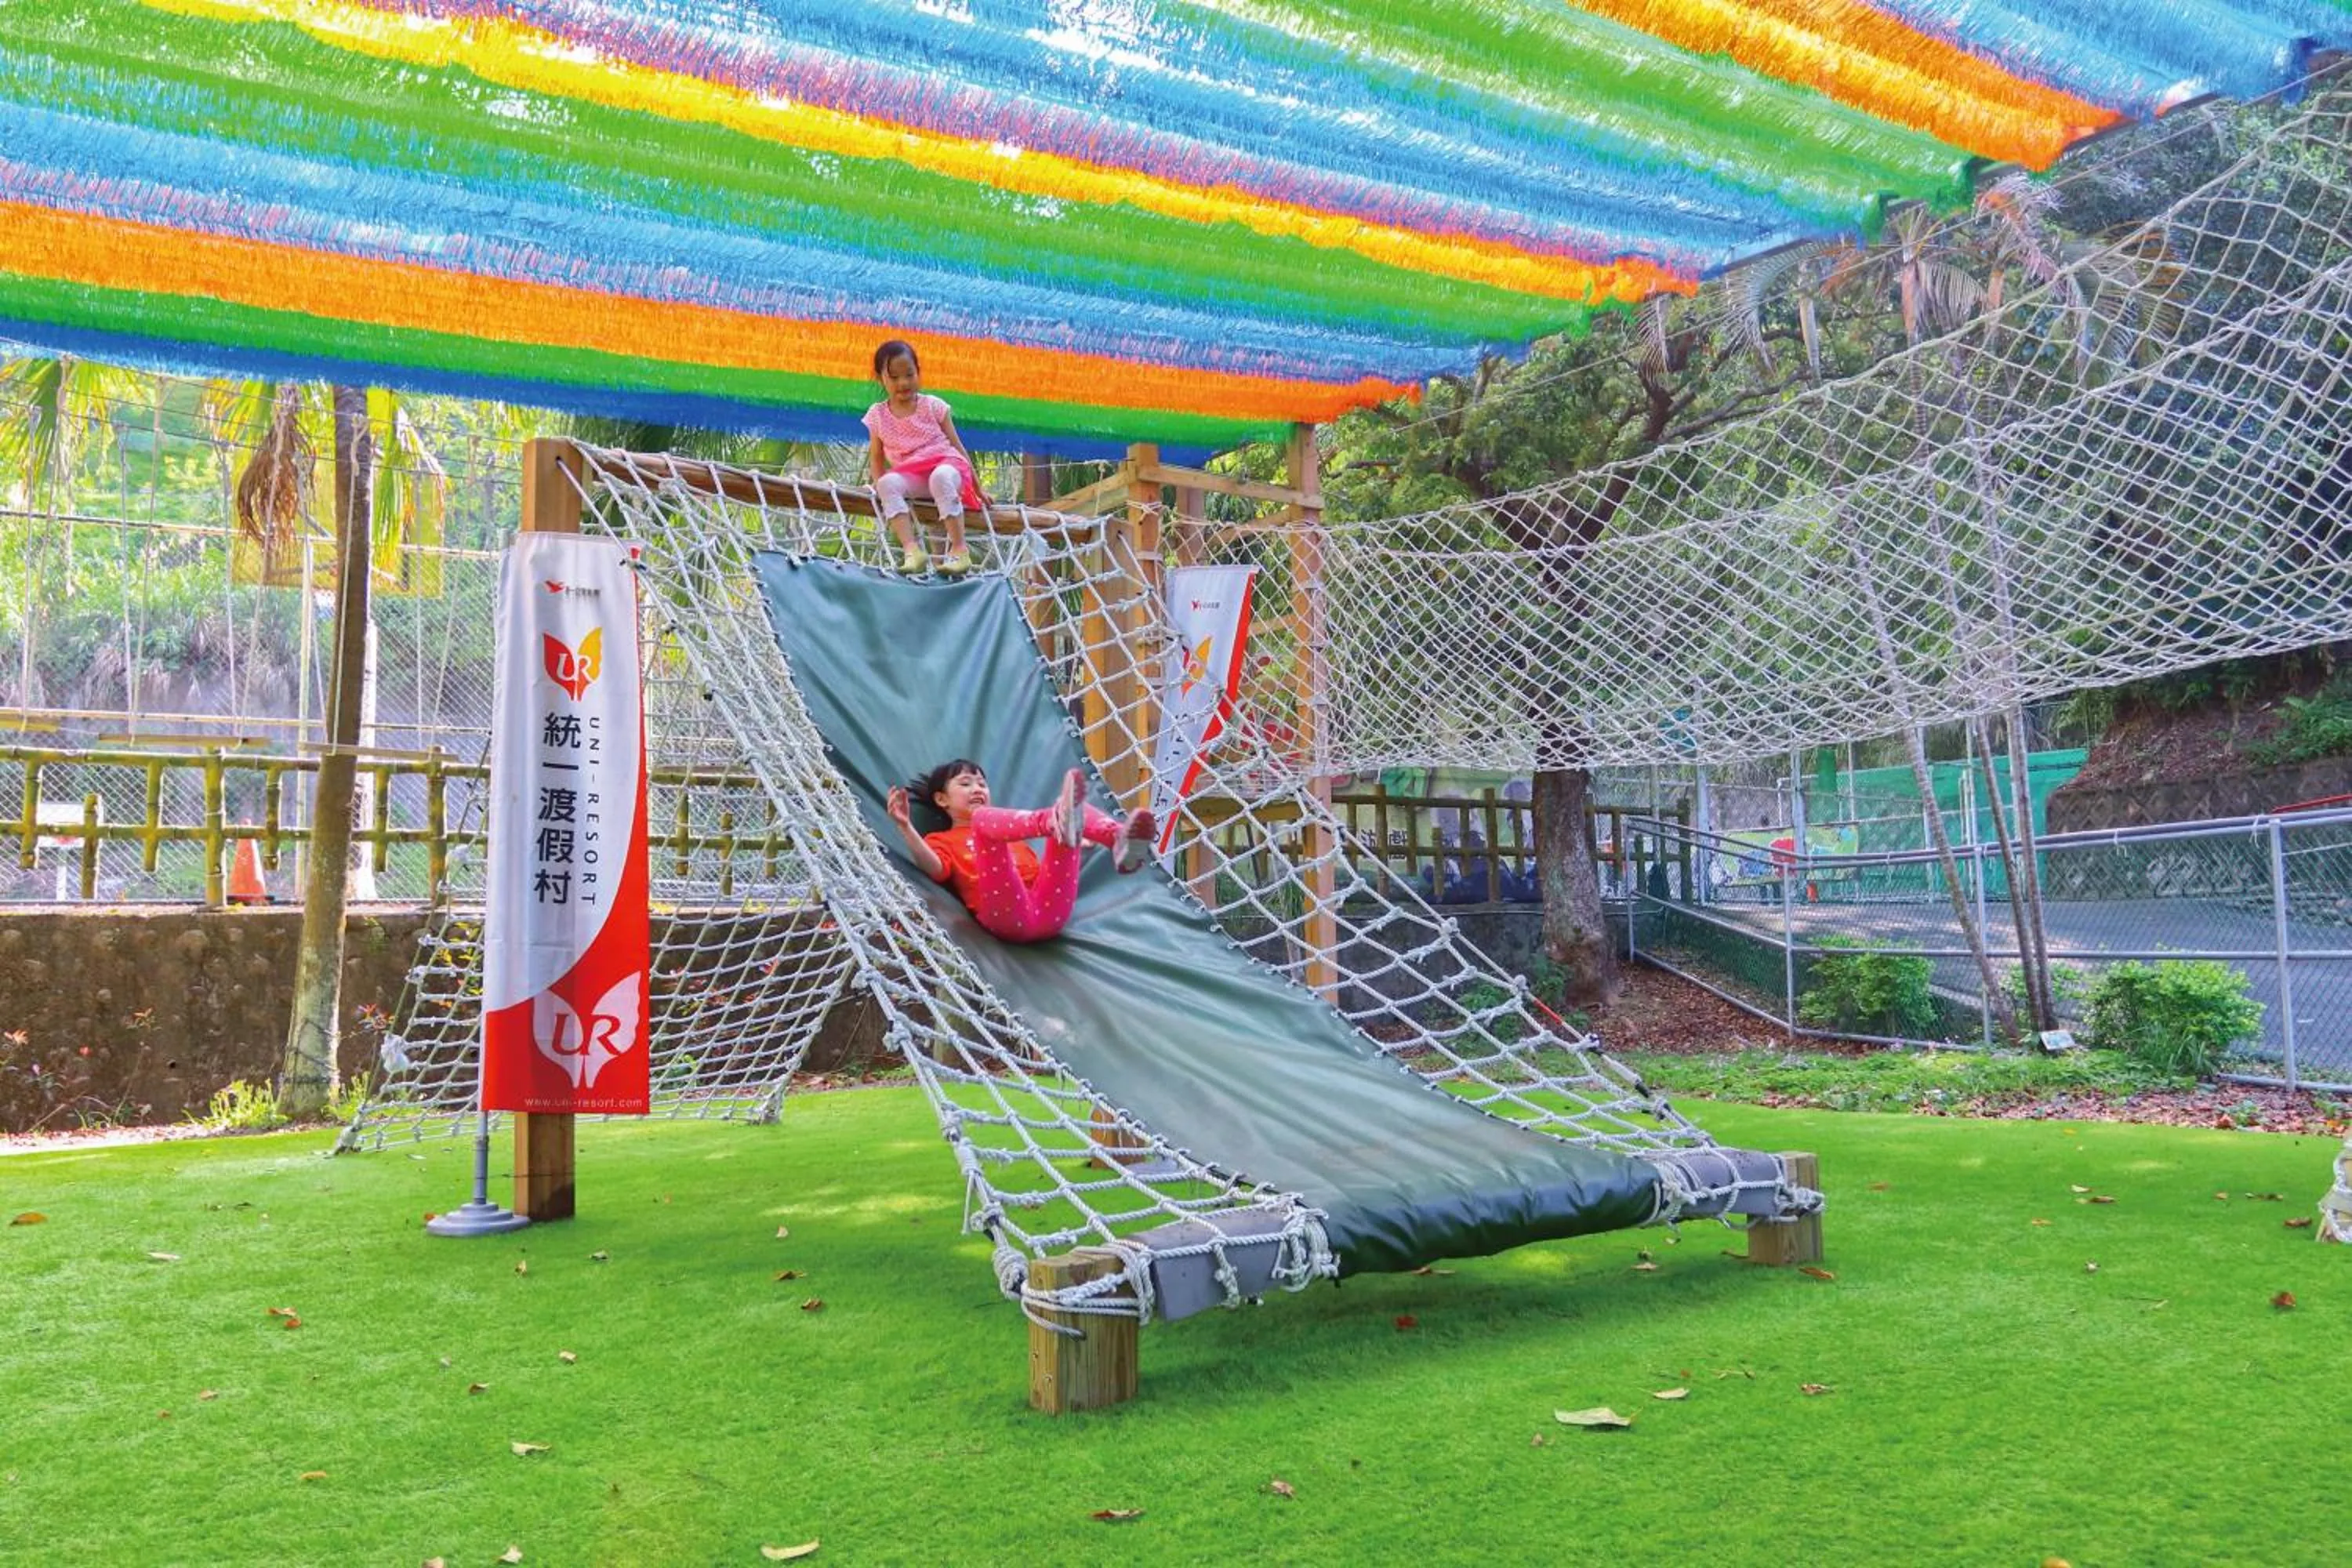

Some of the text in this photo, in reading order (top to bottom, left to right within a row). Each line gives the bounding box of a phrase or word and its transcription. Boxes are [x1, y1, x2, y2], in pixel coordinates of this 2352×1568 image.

[533, 711, 582, 904] 統一渡假村
[581, 717, 600, 905] UNI-RESORT
